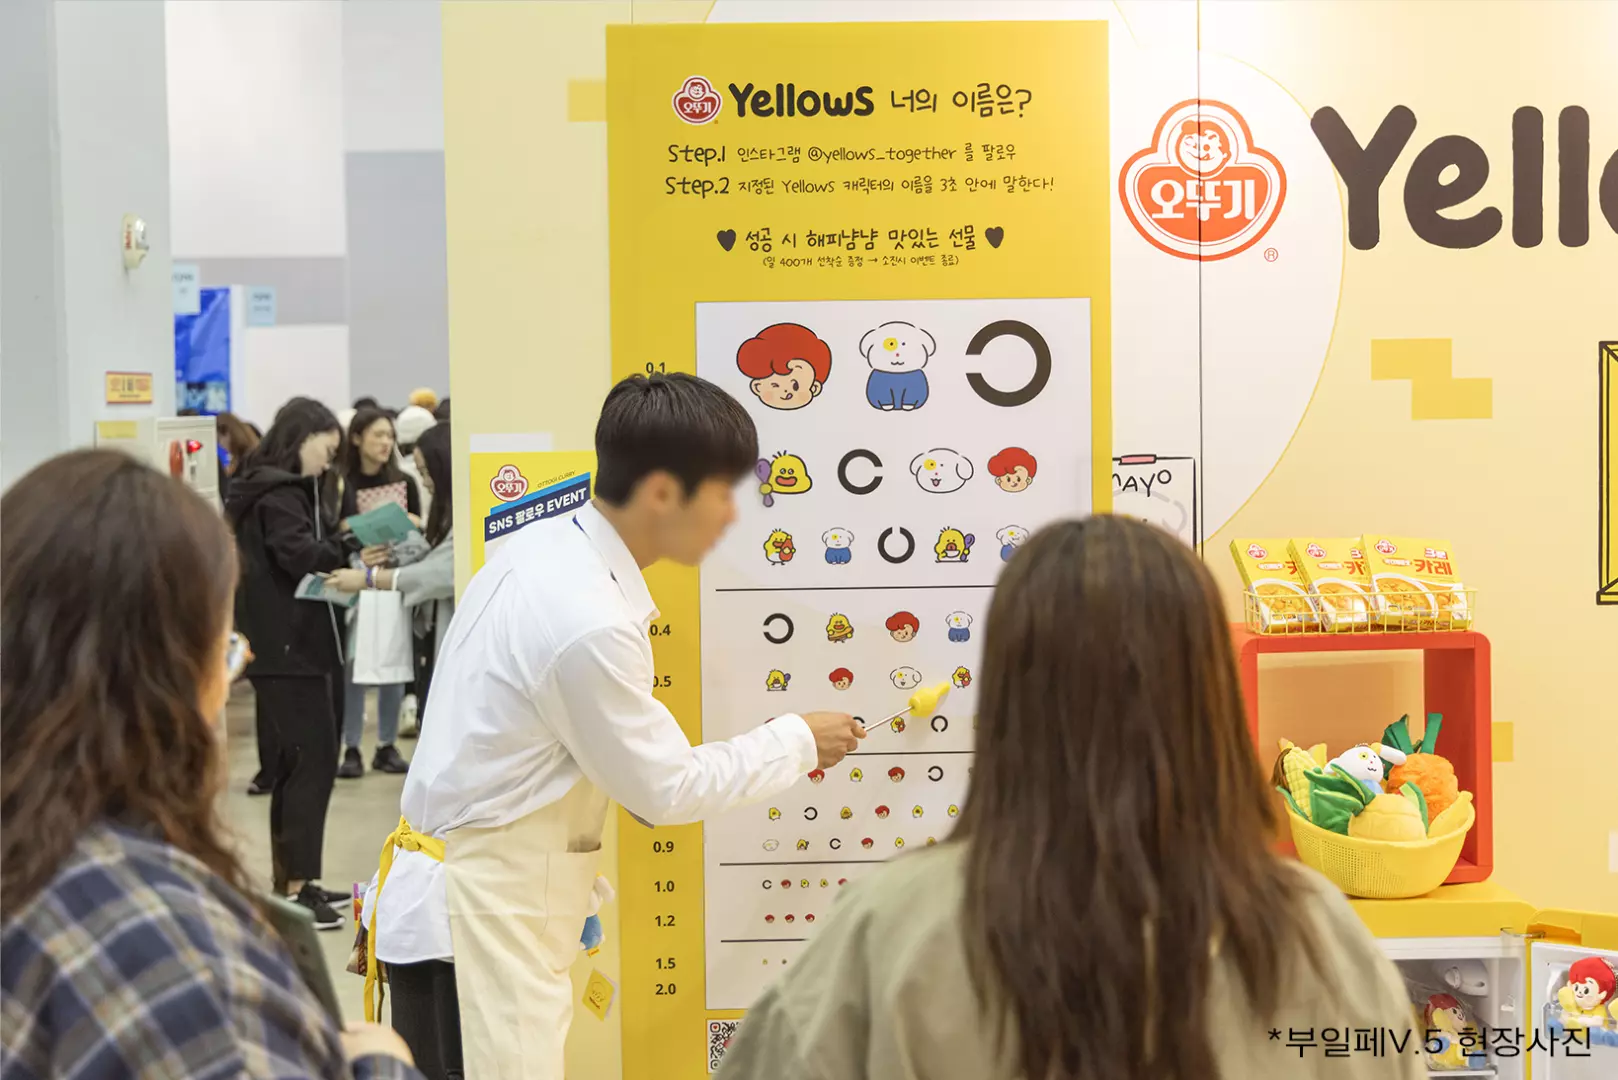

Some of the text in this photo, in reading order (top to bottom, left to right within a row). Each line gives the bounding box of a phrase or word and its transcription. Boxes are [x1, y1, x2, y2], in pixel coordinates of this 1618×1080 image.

[683, 101, 712, 114] 오뚜기
[728, 83, 1033, 118] Yellows 너의 이름은?
[668, 142, 1017, 167] Step.1 인스타그램 @yellows_together 를 팔로우
[1310, 104, 1618, 251] Yell
[665, 174, 1054, 199] Step.2 지정된 Yellows 캐릭터의 이름을 3초 안에 말한다!
[1150, 179, 1255, 221] 오뚜기
[745, 224, 976, 253] 성공 시 해피냠냠 맛있는 선물
[779, 257, 813, 268] 400개
[817, 256, 843, 268] 선착순
[847, 256, 864, 268] 증정
[882, 255, 906, 267] 소진시
[910, 255, 936, 267] 이벤트
[645, 362, 666, 374] 01
[489, 487, 587, 534] SNS 팔로우 EVENT
[1413, 559, 1453, 575] 카레
[649, 623, 672, 637] 0.4
[652, 840, 675, 854] 0.9
[654, 880, 675, 893] 1.0
[654, 914, 676, 927] 1.2
[655, 957, 676, 970] 1.5
[655, 982, 677, 996] 2.0
